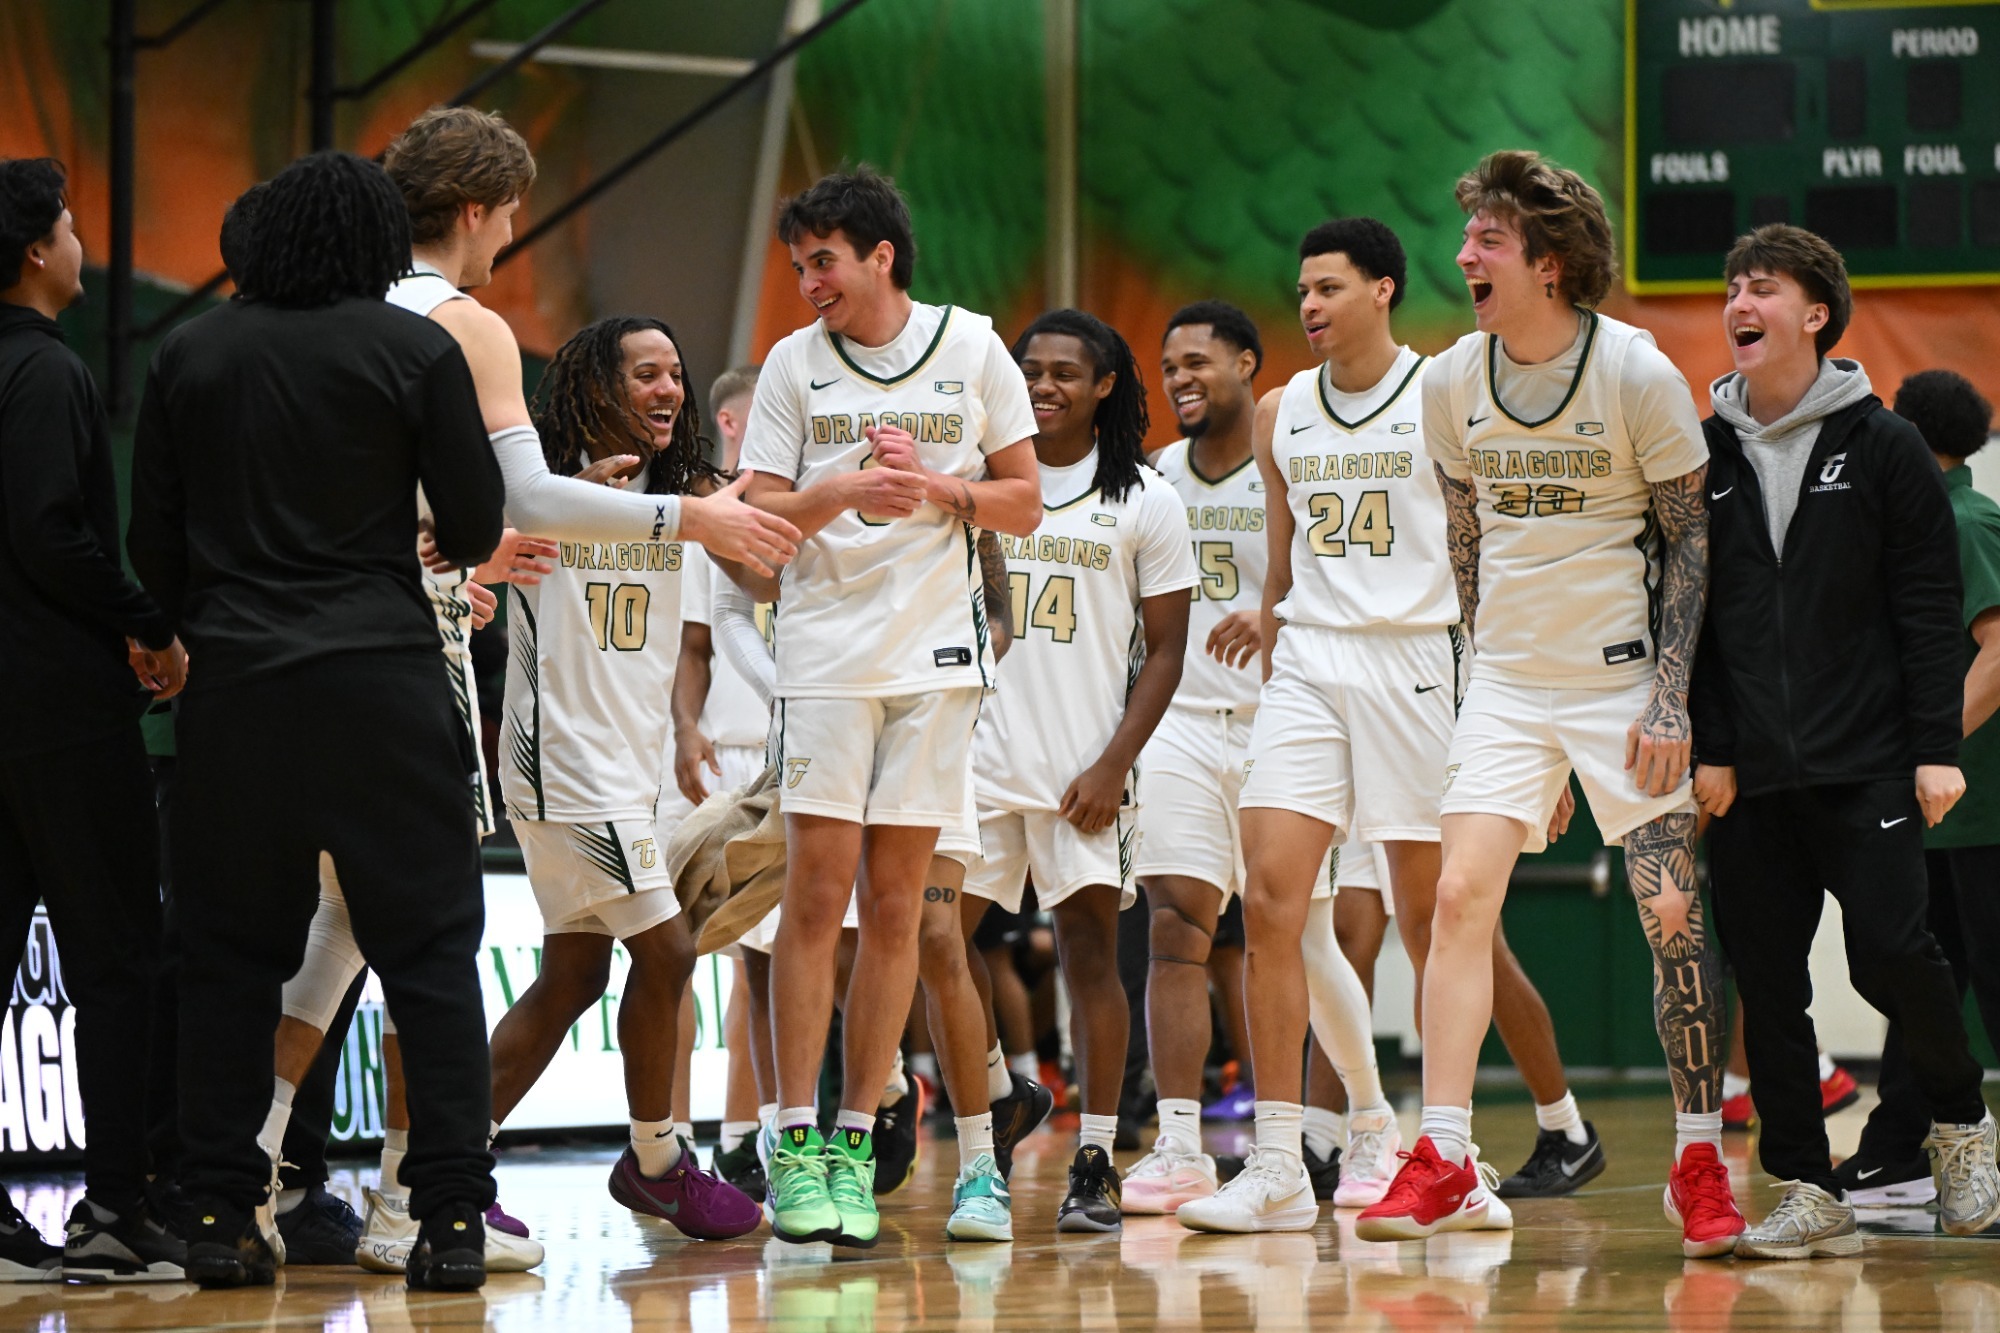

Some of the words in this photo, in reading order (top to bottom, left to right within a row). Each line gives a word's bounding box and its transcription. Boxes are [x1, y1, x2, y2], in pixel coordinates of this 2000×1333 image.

[1678, 14, 1782, 57] HOME
[1891, 26, 1979, 58] PERIOD
[1650, 150, 1730, 184] FOULS
[1822, 146, 1883, 179] PLYR
[1903, 144, 1966, 176] FOUL
[1289, 450, 1412, 483] DRAGONS
[1469, 448, 1612, 479] DRAGONS
[1307, 490, 1394, 557] 24
[559, 541, 683, 571] DRAGONS
[1190, 541, 1239, 601] 5
[585, 581, 650, 651] 10
[1007, 571, 1076, 643] 14
[1662, 938, 1699, 959] HOME
